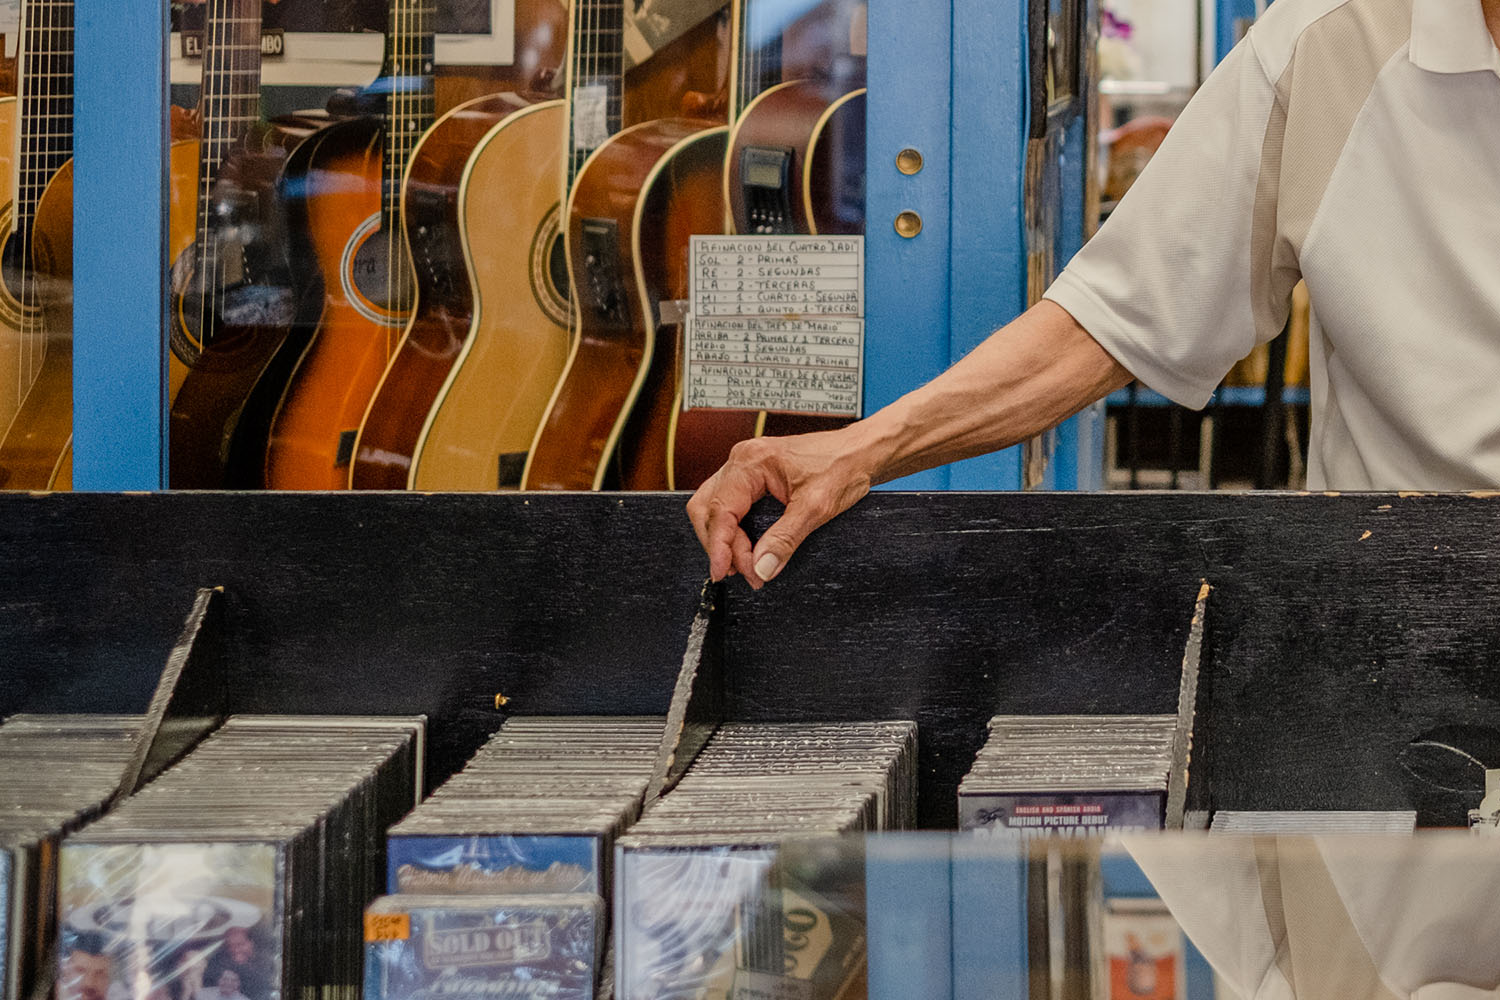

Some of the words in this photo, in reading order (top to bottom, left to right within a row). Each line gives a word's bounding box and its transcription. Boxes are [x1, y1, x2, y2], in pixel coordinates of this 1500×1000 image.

[699, 256, 721, 265] SOL
[757, 254, 800, 264] PRIMAS
[702, 268, 718, 278] RE
[757, 267, 822, 277] SEGUNDAS
[701, 280, 719, 290] LA
[754, 280, 816, 290] TERCERAS
[702, 295, 717, 304] MI
[756, 292, 797, 302] CUARTO
[702, 305, 717, 315] SI
[1014, 805, 1040, 815] ENGLISH
[1041, 805, 1055, 815] AND
[1055, 804, 1082, 815] SPANISH
[1082, 804, 1102, 814] AUDIO
[1008, 815, 1043, 827] MOTION
[1043, 814, 1081, 827] PICTURE
[1081, 813, 1109, 826] DEBUT
[430, 932, 491, 951] SOLD
